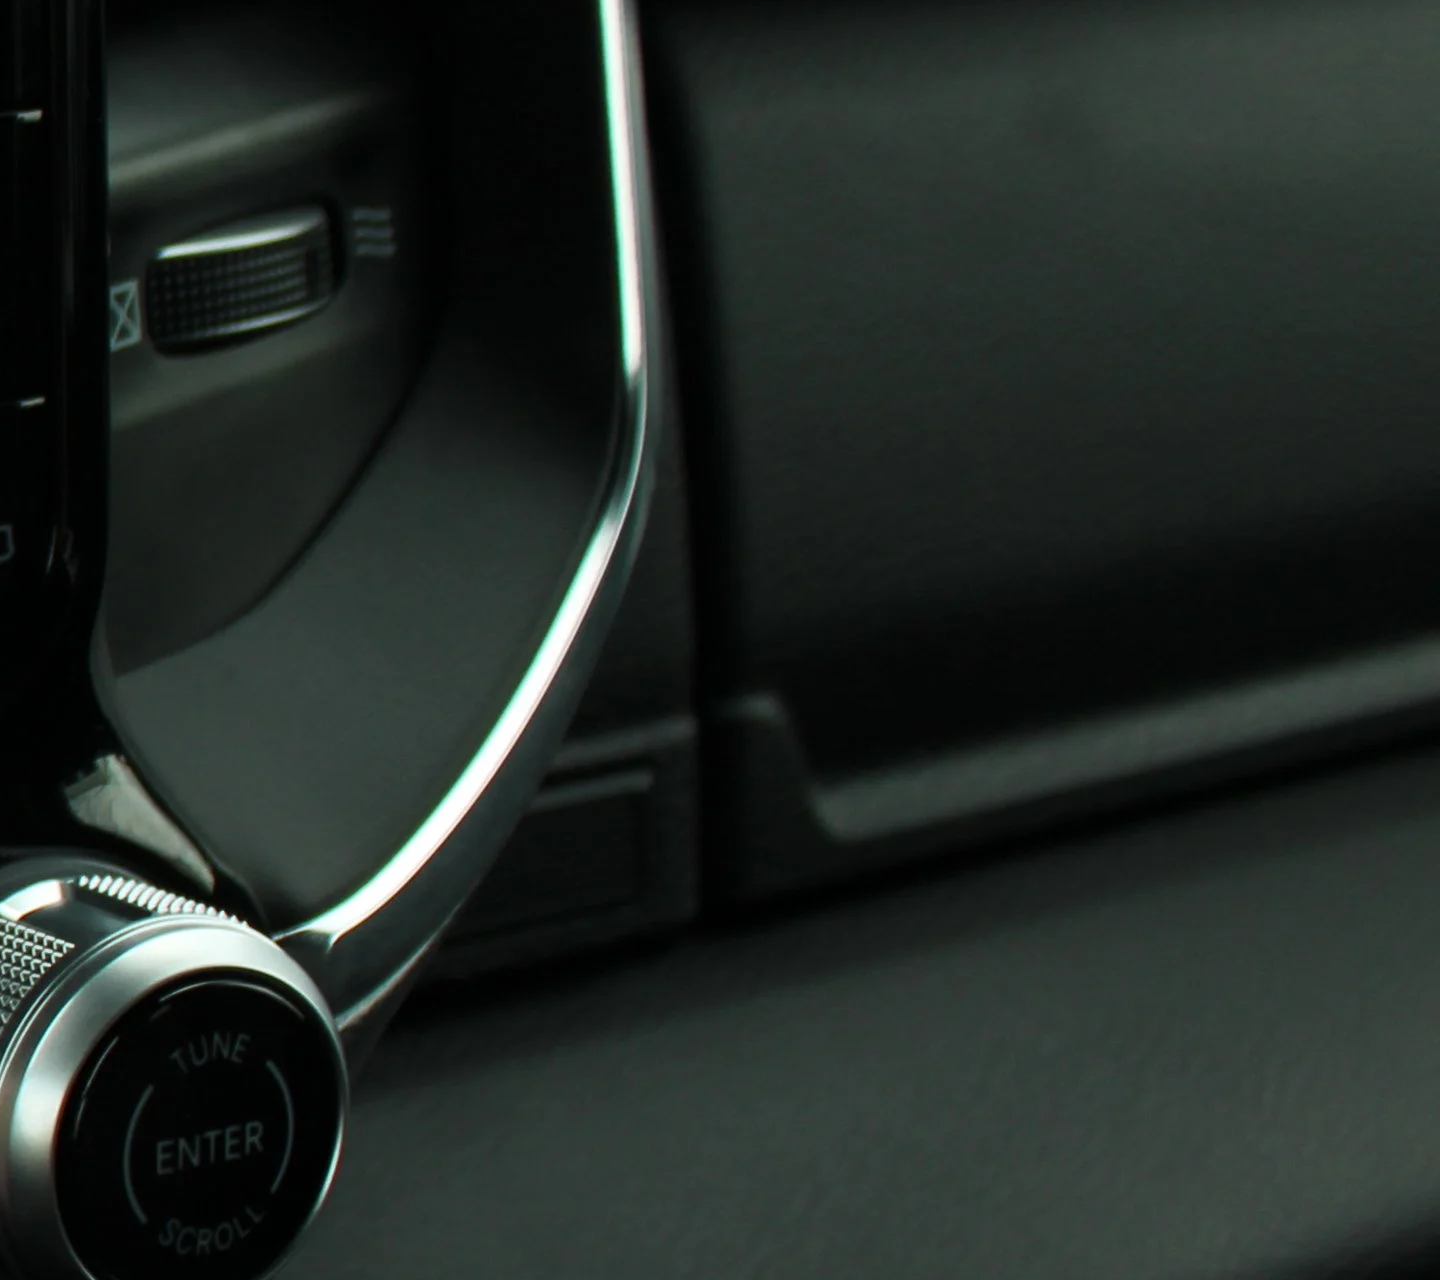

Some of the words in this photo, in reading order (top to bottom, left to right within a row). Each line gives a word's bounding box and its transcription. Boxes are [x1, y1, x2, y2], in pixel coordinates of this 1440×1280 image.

[170, 1031, 251, 1075] TUNE
[156, 1121, 265, 1176] ENTER
[158, 1203, 270, 1257] SCROLL
